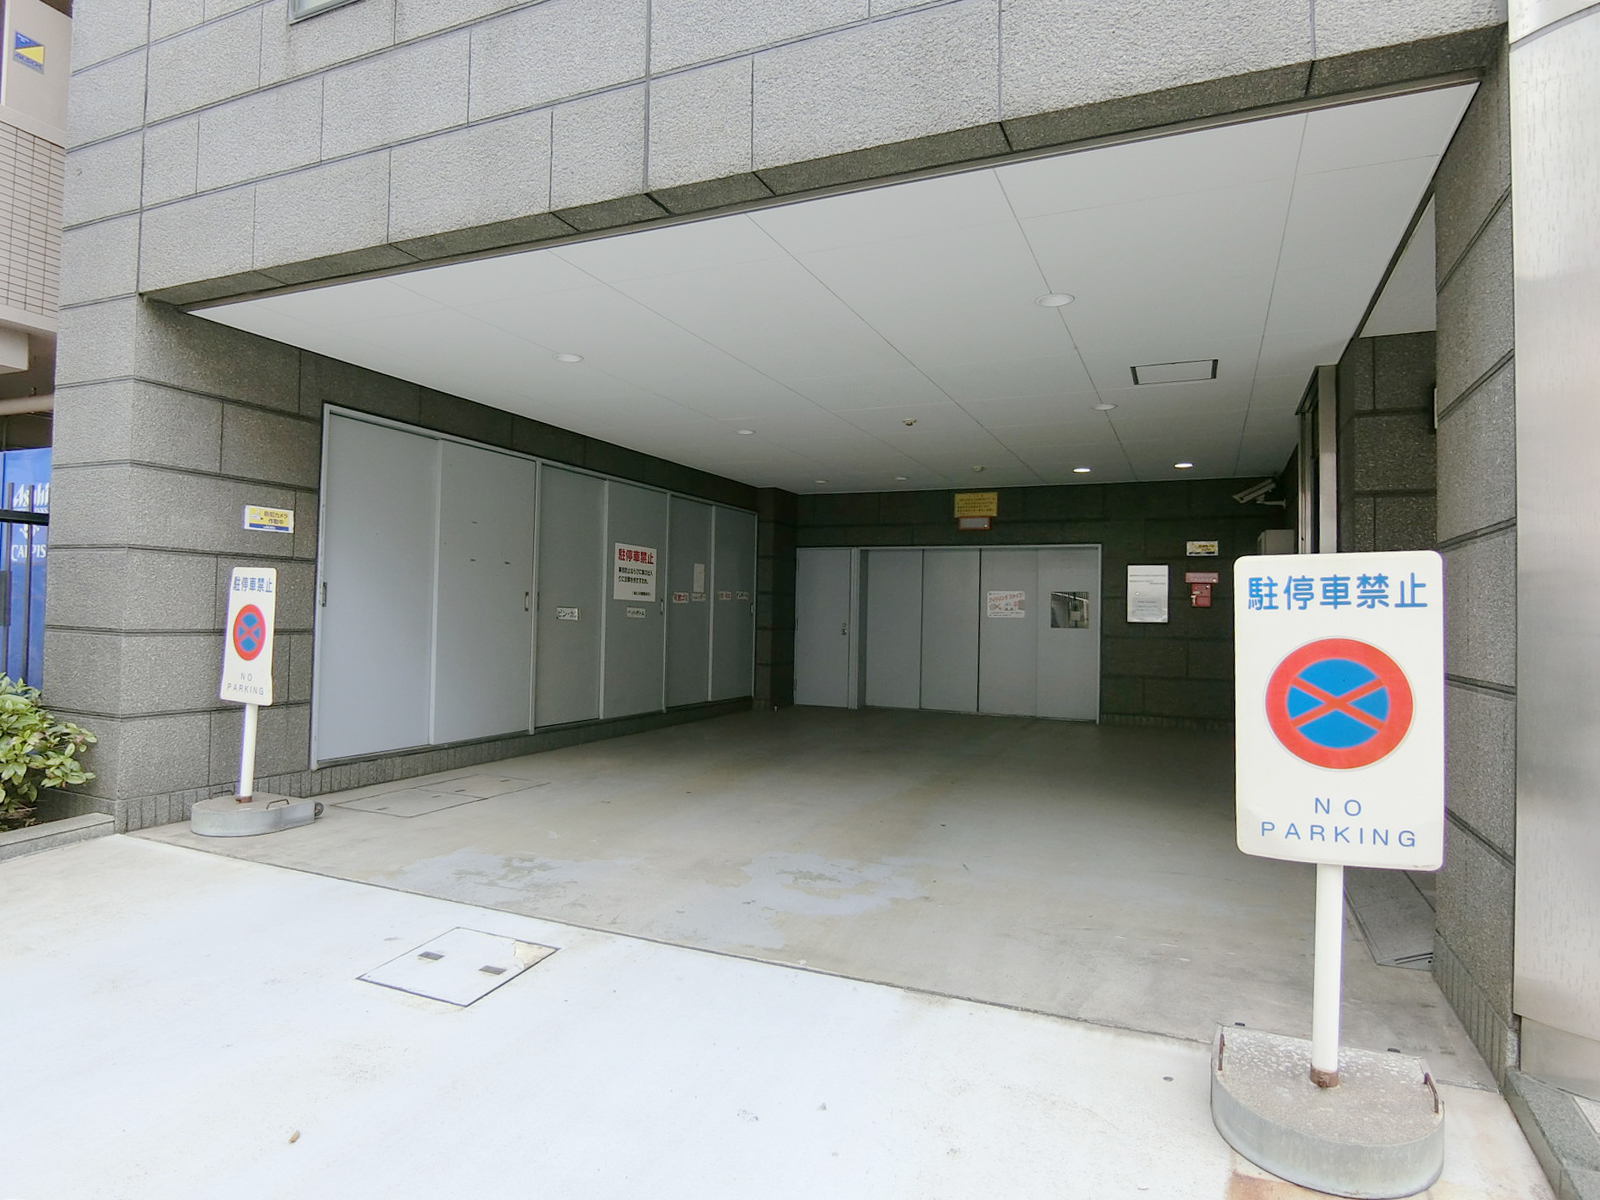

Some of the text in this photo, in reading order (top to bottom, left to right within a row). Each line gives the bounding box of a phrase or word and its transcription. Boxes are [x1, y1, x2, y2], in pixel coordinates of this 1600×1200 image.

[618, 548, 654, 565] 駐停車禁止
[232, 576, 273, 593] 駐停車禁止
[1247, 572, 1428, 611] 駐停車禁止
[240, 673, 253, 682] NO
[227, 684, 265, 696] PARKING
[1314, 797, 1362, 817] NO
[1261, 821, 1416, 848] PARKING
